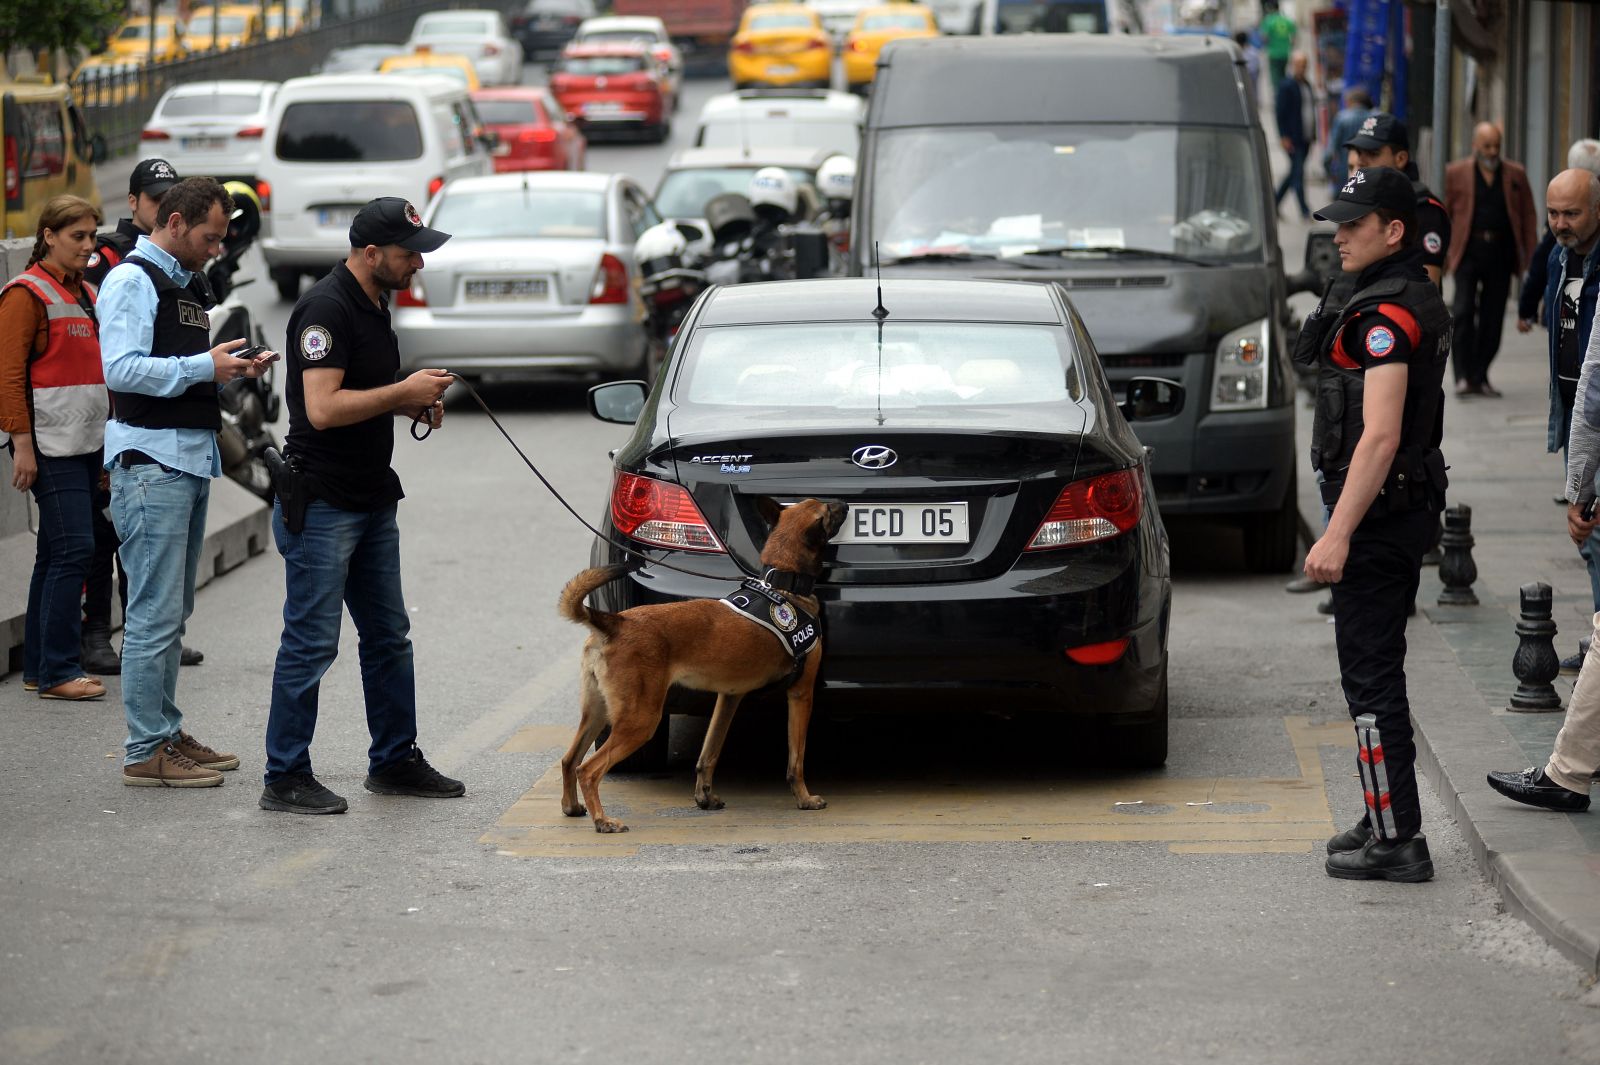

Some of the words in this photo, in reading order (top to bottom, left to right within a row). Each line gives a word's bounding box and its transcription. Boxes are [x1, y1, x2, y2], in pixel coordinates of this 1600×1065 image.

[688, 454, 754, 464] ACCENT
[720, 463, 752, 474] blue
[854, 508, 904, 537] ECD
[921, 508, 954, 537] 05
